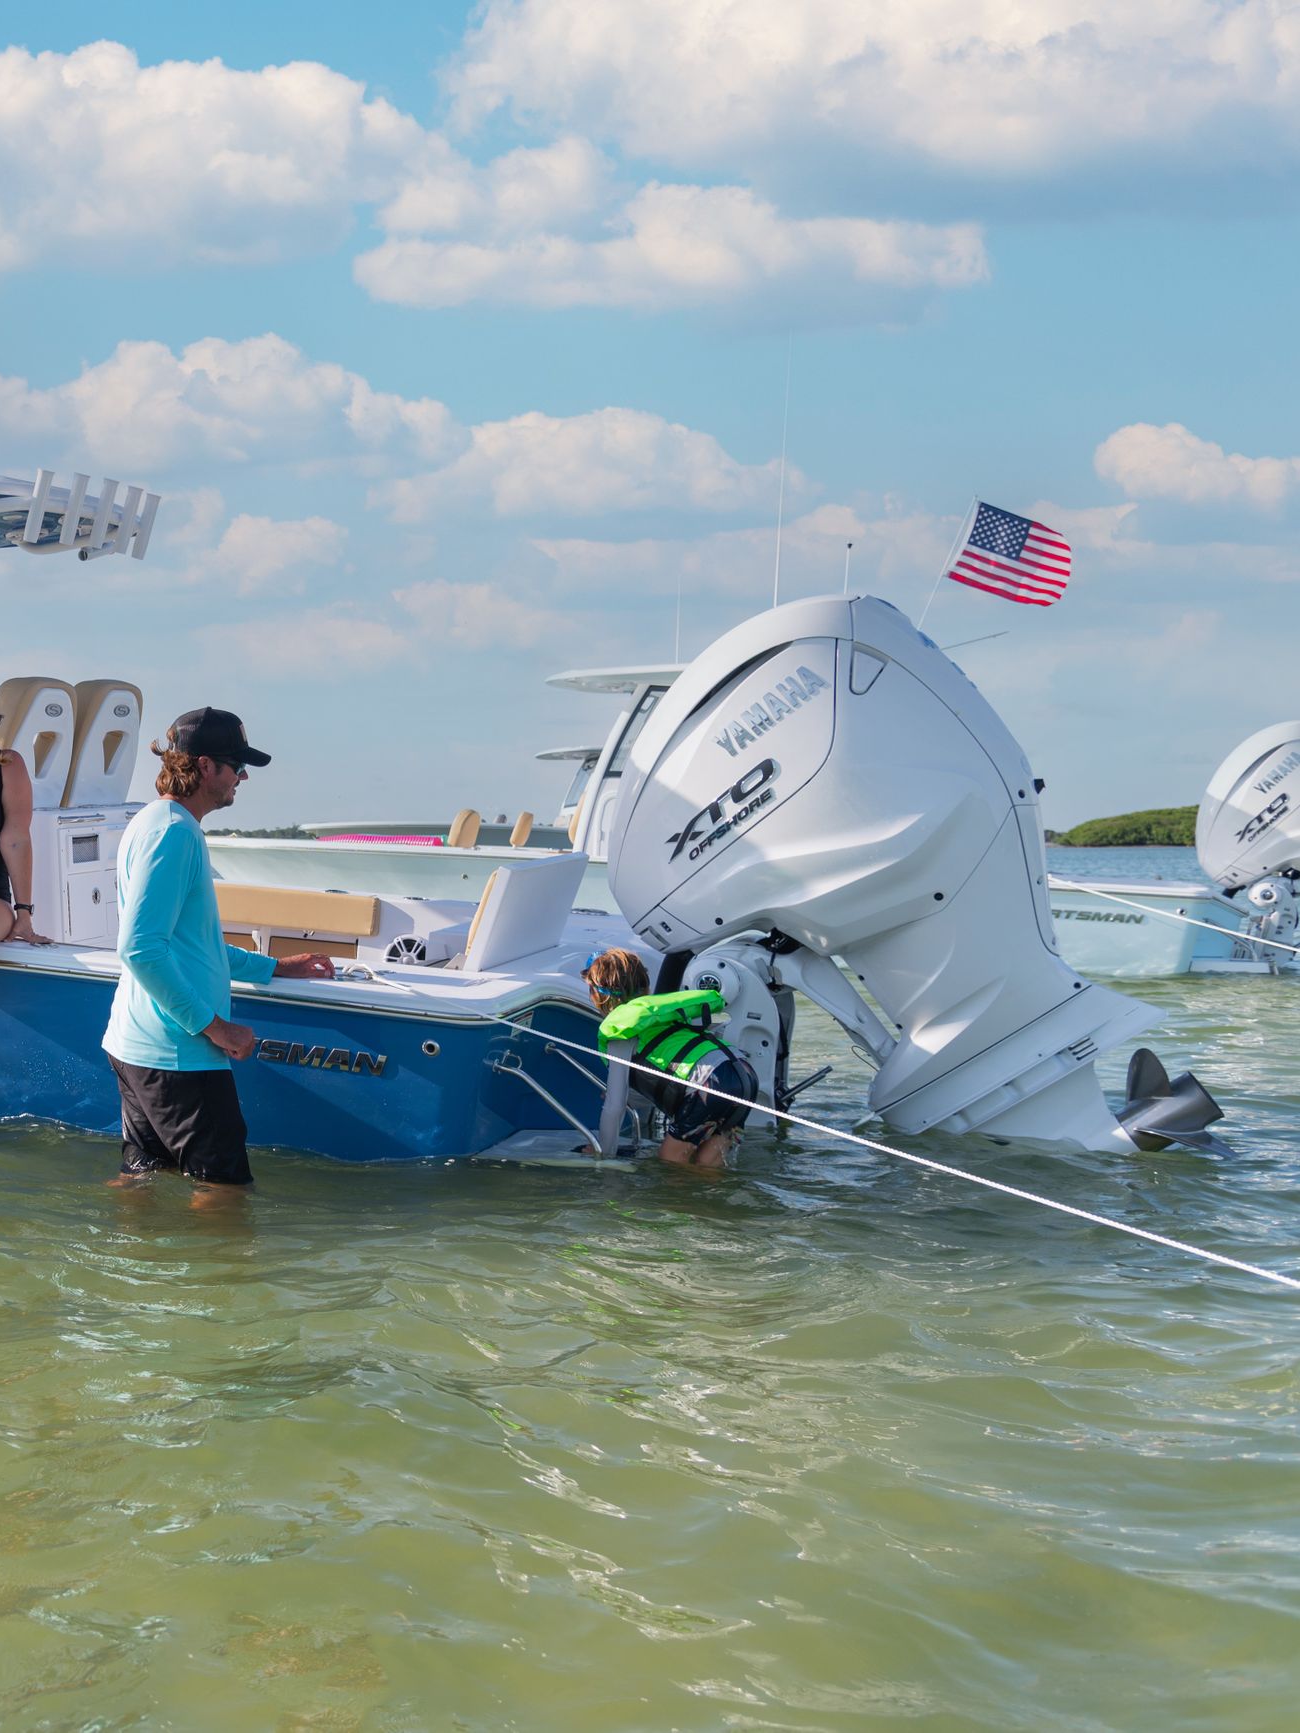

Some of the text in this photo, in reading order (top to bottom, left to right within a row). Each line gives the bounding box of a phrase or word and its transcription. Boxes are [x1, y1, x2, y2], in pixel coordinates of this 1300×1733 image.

[714, 665, 831, 757] YAMAHA
[666, 758, 780, 864] XTO
[689, 787, 774, 861] OFFSHORE
[1234, 793, 1288, 844] XTO
[254, 1037, 387, 1076] SMAN
